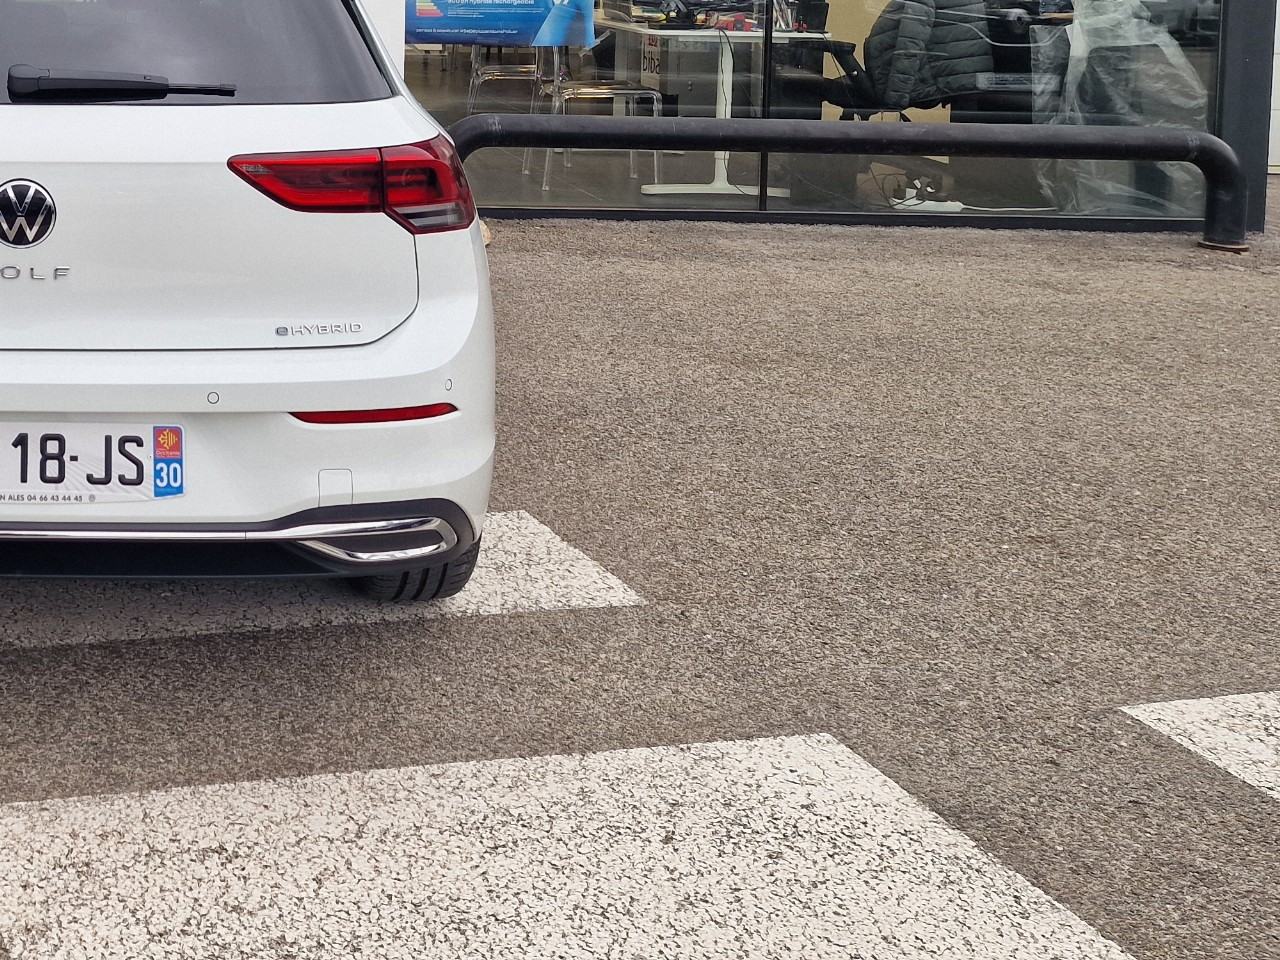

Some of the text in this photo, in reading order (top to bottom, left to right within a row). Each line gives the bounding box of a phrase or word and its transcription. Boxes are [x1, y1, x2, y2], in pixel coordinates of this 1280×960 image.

[155, 462, 182, 488] 30
[8, 494, 25, 502] ALES
[27, 494, 37, 502] 04
[39, 494, 49, 502] 66
[51, 494, 60, 502] 43
[62, 494, 71, 502] 44
[74, 494, 83, 502] 45
